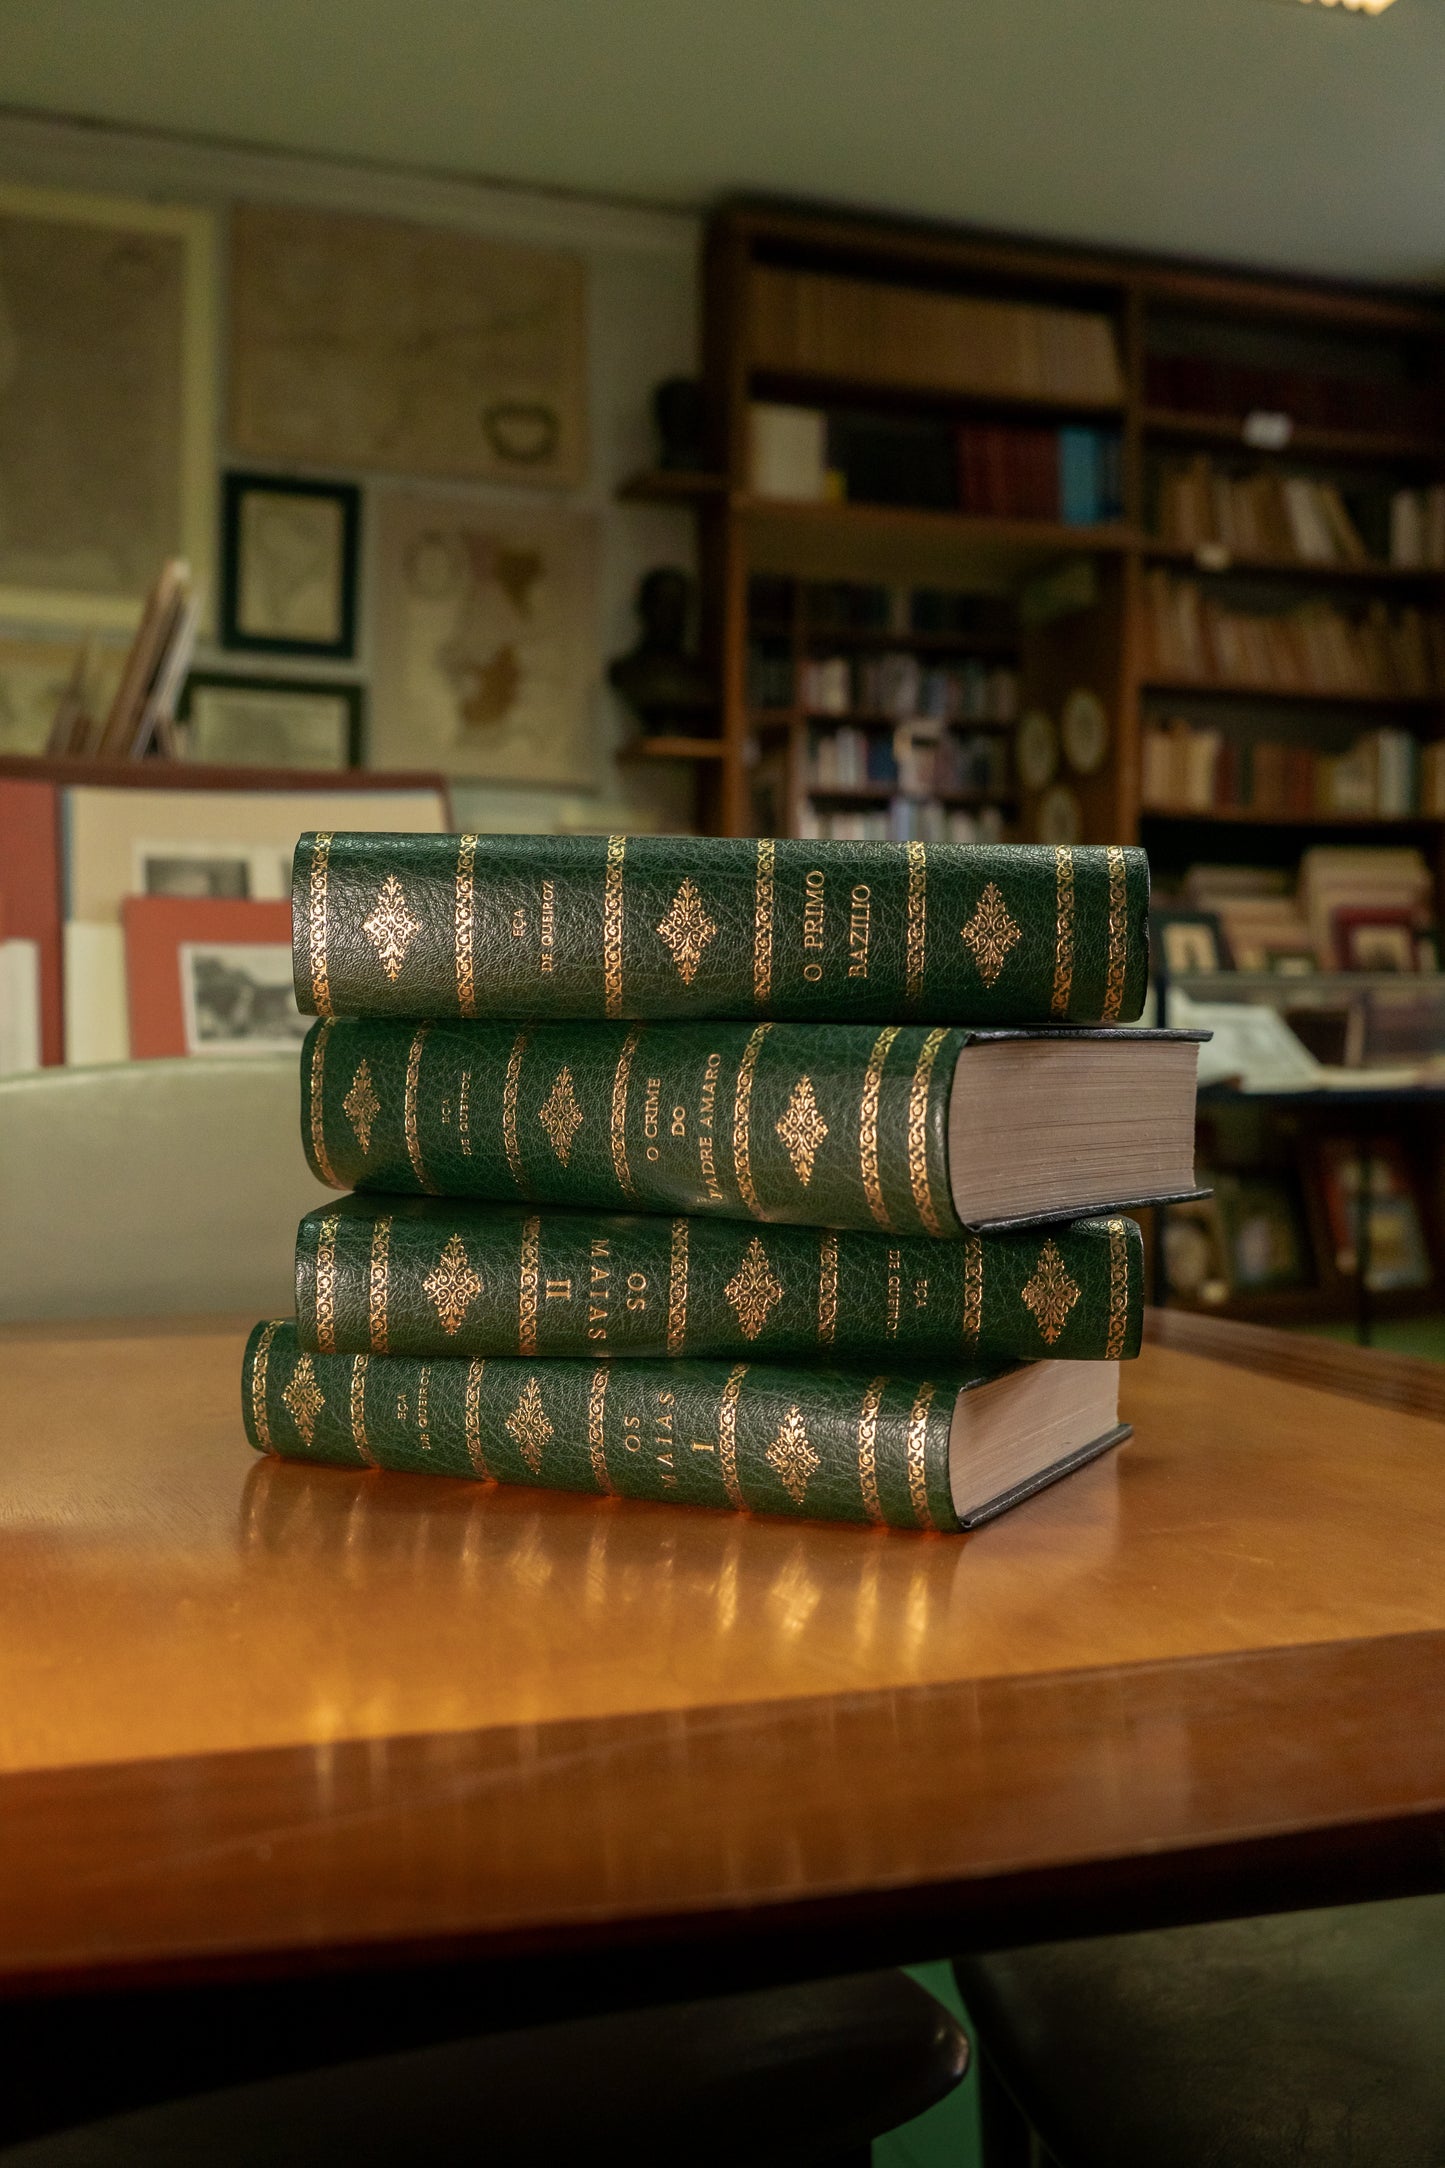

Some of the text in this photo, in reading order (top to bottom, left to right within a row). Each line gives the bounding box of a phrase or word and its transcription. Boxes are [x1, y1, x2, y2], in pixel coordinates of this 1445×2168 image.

[513, 908, 527, 937] EÇA
[541, 880, 555, 972] DE QUEIROZ
[803, 870, 825, 982] O PRIMO
[848, 884, 871, 978] BAZILIO
[442, 1099, 451, 1124] EÇA
[459, 1071, 472, 1156] DE QUEIROZ
[644, 1078, 661, 1161] O CRIME
[671, 1106, 686, 1137] DO
[699, 1053, 723, 1200] PADRE AMARO
[888, 1250, 900, 1269] DE
[545, 1279, 571, 1301] II
[587, 1239, 610, 1339] MAIAS
[626, 1272, 647, 1310] OS
[912, 1280, 928, 1309] EÇA
[397, 1394, 408, 1420] EÇA
[418, 1367, 431, 1450] DE QUEIROZ
[624, 1416, 641, 1452] OS
[656, 1392, 677, 1488] MAIAS
[691, 1440, 714, 1453] I
